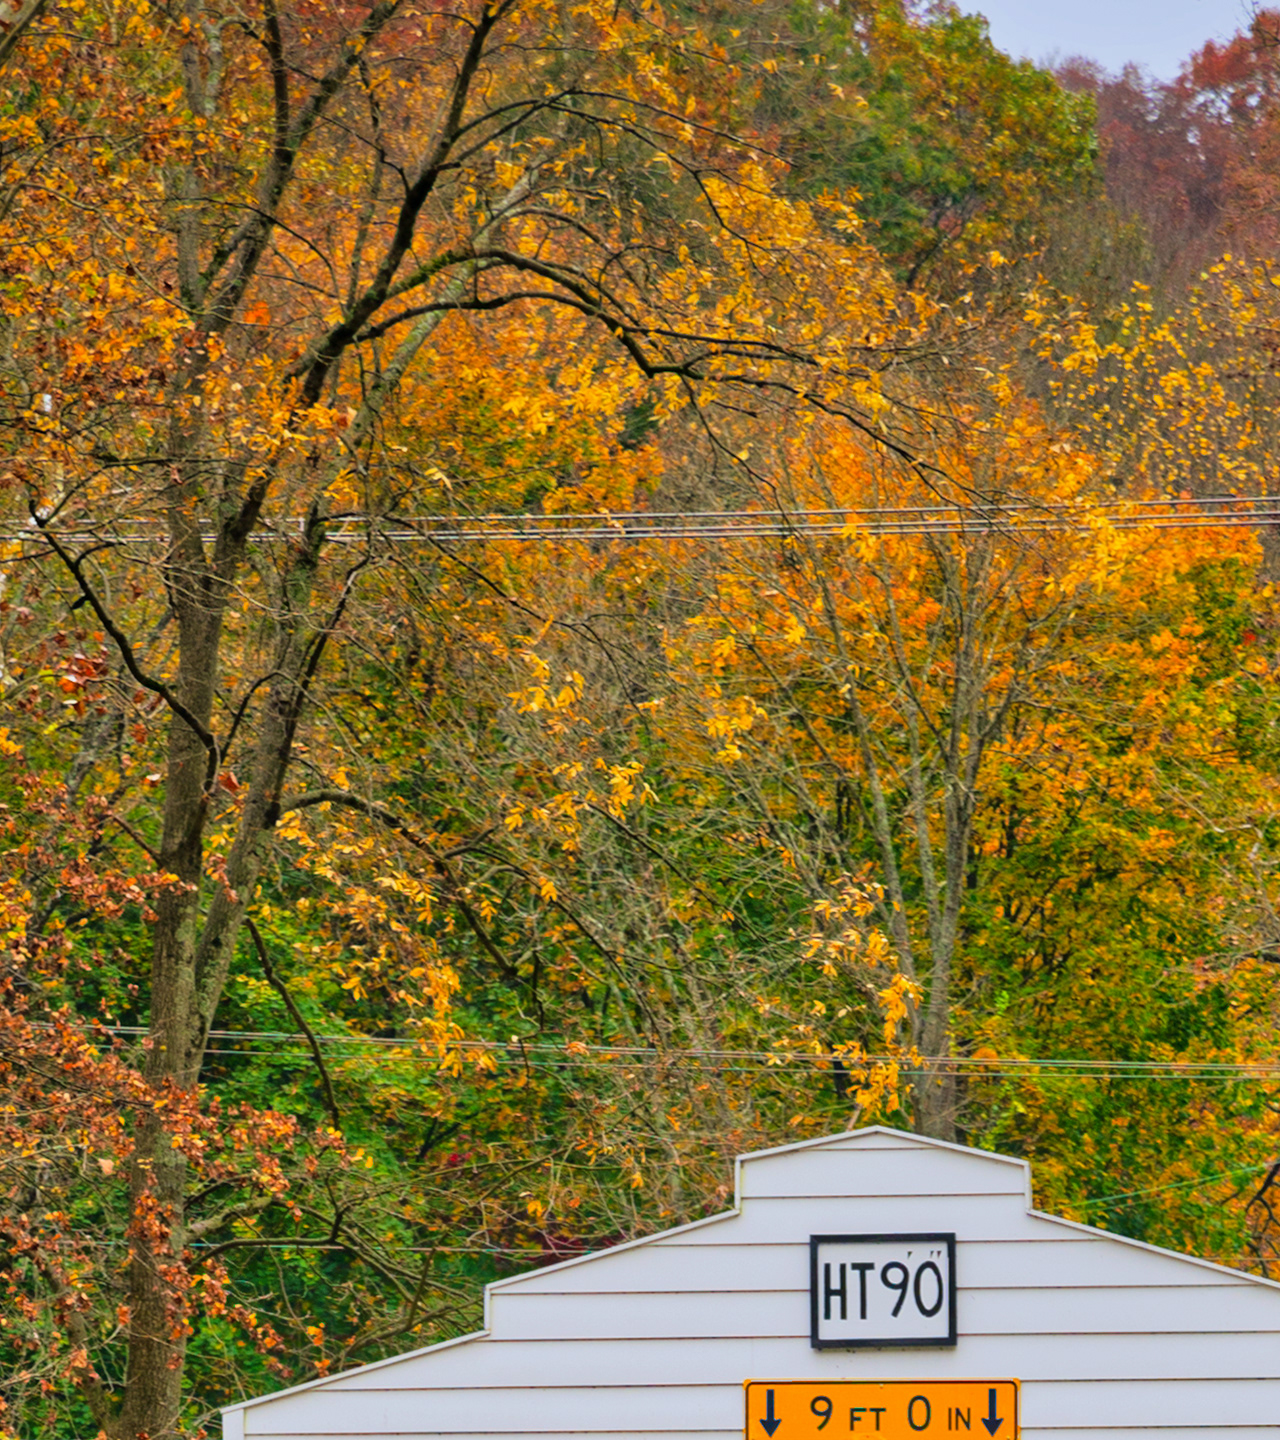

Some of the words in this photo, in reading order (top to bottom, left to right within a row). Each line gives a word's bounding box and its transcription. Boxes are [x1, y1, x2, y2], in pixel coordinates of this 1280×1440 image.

[810, 1395, 833, 1431] 9
[849, 1407, 887, 1431] FT
[947, 1407, 971, 1431] IN
